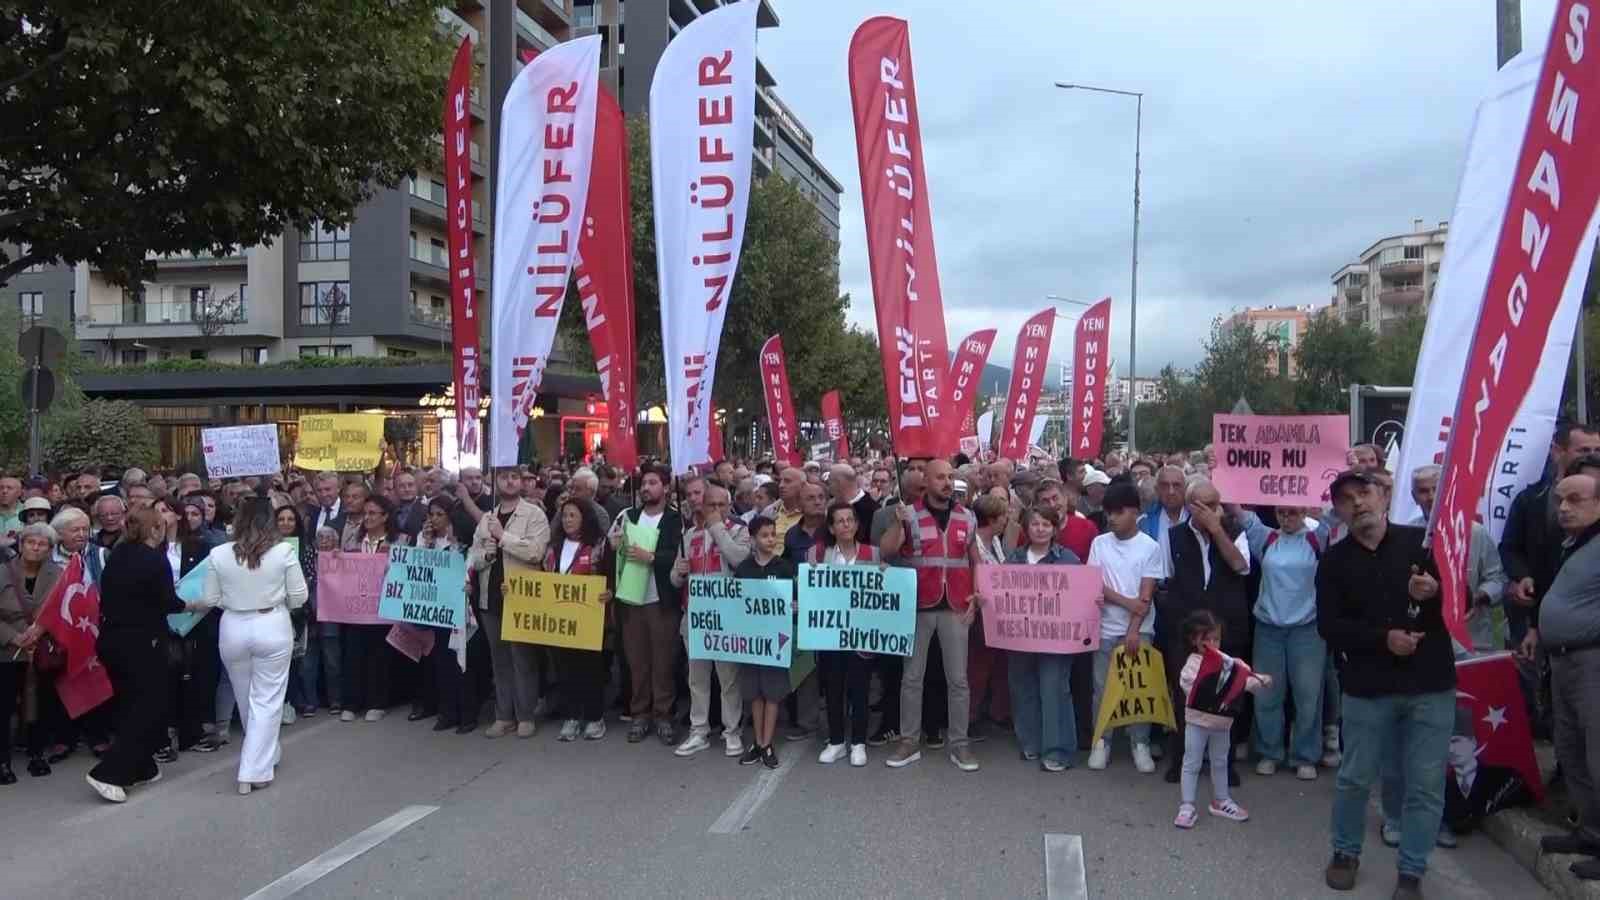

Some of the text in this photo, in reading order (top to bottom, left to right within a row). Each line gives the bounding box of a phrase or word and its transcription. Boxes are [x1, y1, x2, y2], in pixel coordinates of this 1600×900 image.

[690, 50, 735, 312] NİLÜFER
[527, 80, 579, 318] NİLÜFER
[918, 339, 940, 418] PARTİ
[1009, 346, 1038, 449] MUDANYA
[1080, 341, 1098, 449] MUDANYA
[1219, 423, 1247, 444] TEK
[1493, 427, 1527, 520] PARTİ
[1259, 474, 1310, 497] GEÇER
[391, 546, 408, 564] SİZ
[385, 581, 404, 599] BİZ
[509, 576, 587, 602] YİNE YENİ
[689, 577, 743, 600] GENÇLİĞE
[807, 566, 884, 591] ETİKETLER
[745, 598, 786, 616] SABIR
[850, 588, 900, 611] BİZDEN
[513, 612, 577, 636] YENİDEN
[691, 609, 723, 631] DEĞİL
[808, 610, 850, 629] HIZLI
